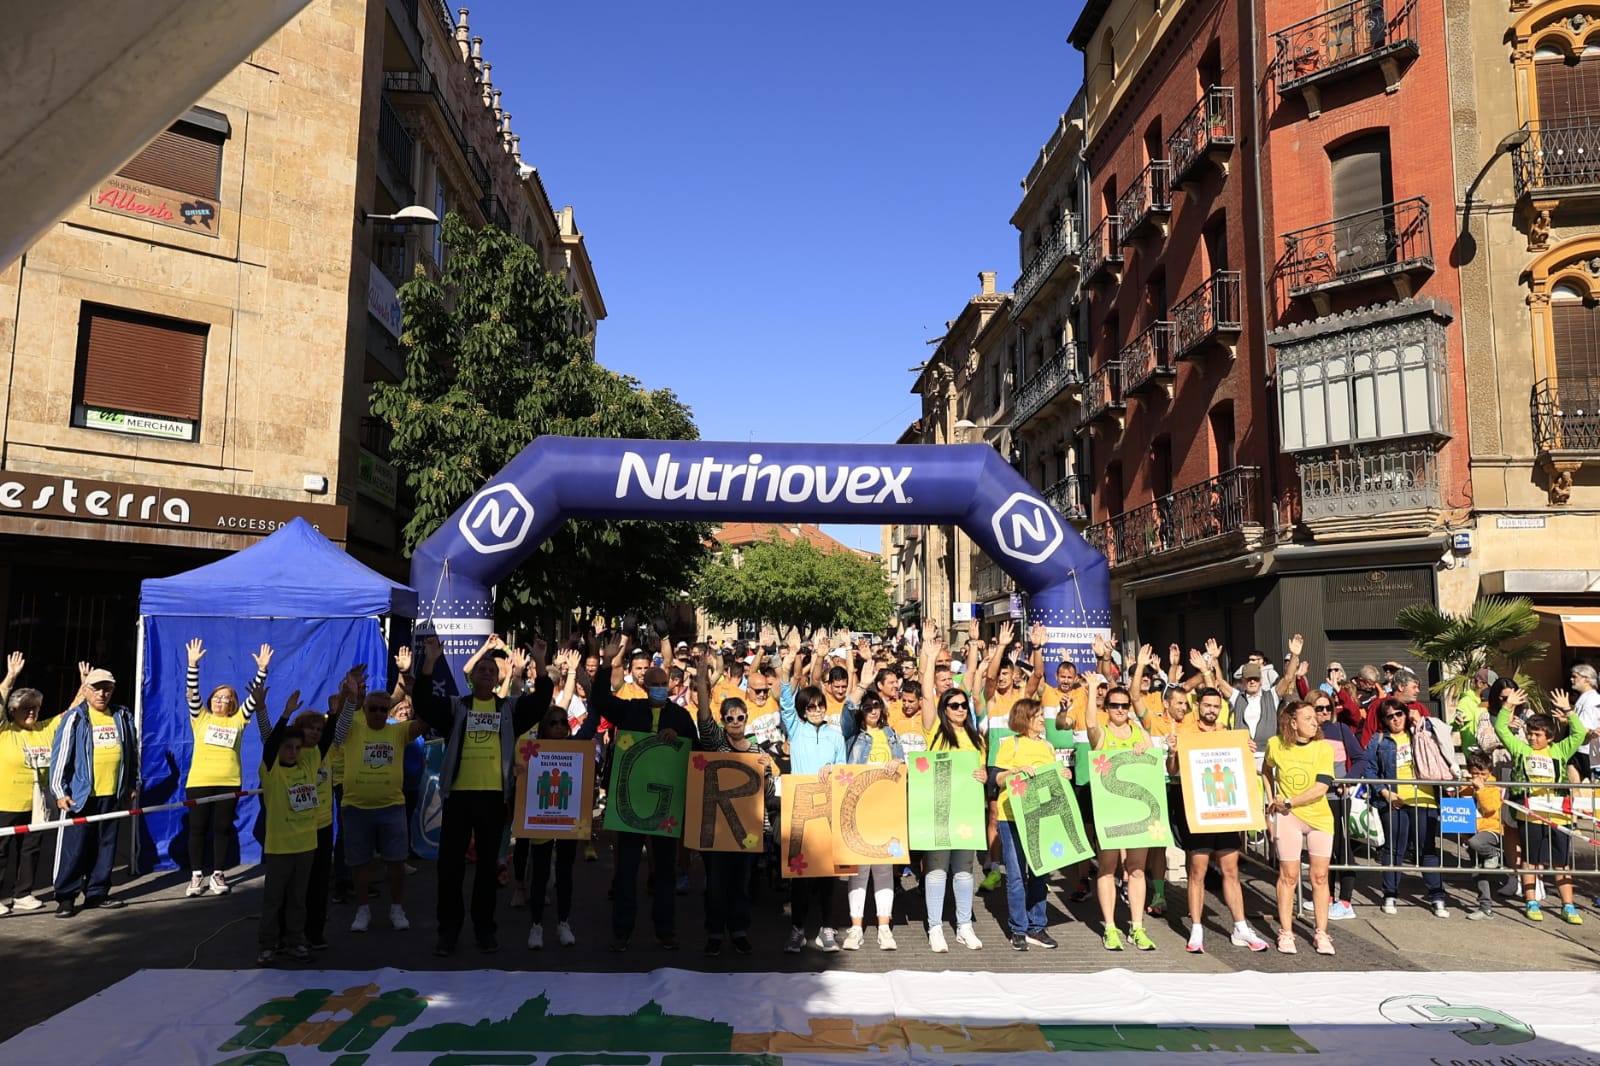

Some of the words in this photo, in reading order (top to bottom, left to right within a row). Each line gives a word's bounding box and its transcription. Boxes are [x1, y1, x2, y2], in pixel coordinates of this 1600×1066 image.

[97, 189, 174, 221] Alberto
[127, 418, 184, 433] MERCHAN
[615, 451, 912, 504] Nutrinovex
[98, 732, 116, 740] 433
[212, 731, 230, 741] 453
[370, 750, 388, 759] 405
[1440, 806, 1471, 816] POLICIA
[1441, 815, 1469, 825] LOCAL
